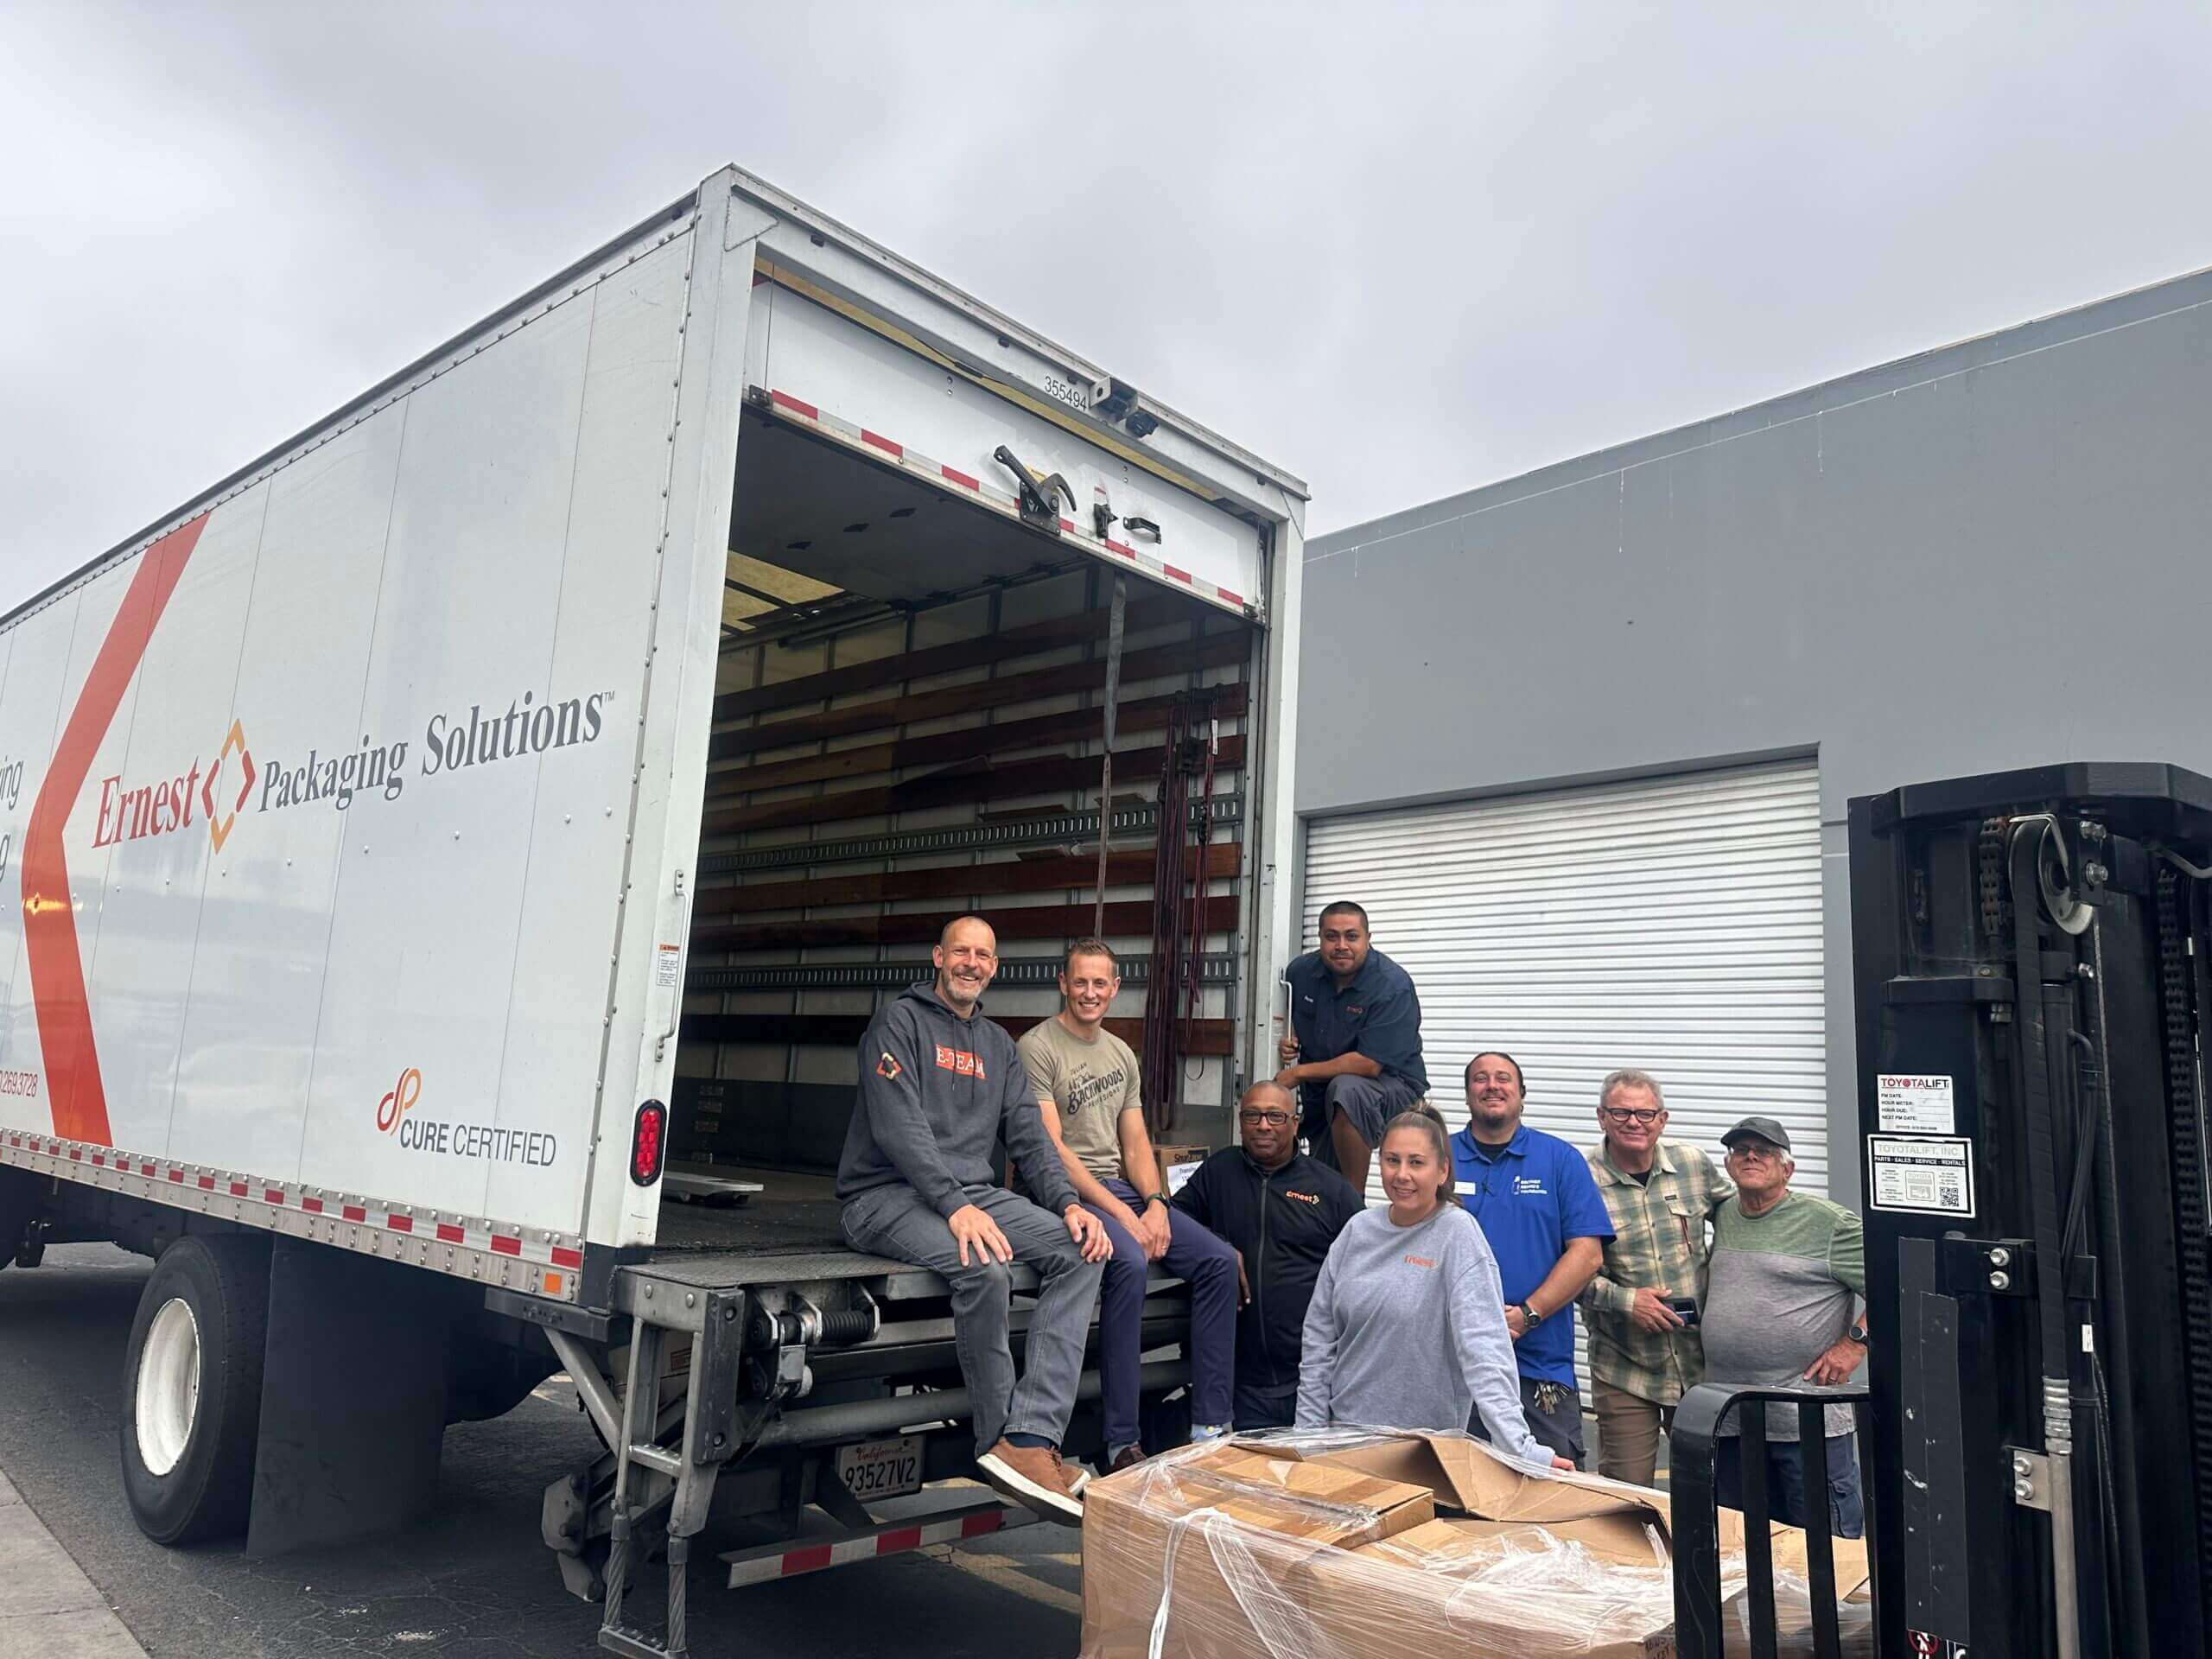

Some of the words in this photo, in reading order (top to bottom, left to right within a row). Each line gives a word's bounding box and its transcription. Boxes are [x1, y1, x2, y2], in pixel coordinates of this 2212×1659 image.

[1044, 375, 1087, 412] 355494
[0, 754, 24, 810] ing
[91, 755, 200, 849] Ernest
[257, 734, 409, 812] Packaging
[421, 690, 604, 777] Solutions
[936, 1046, 985, 1077] E-TEAM
[400, 1119, 449, 1154] CURE
[453, 1124, 556, 1166] CERTIFIED
[845, 1457, 916, 1491] 93527V2
